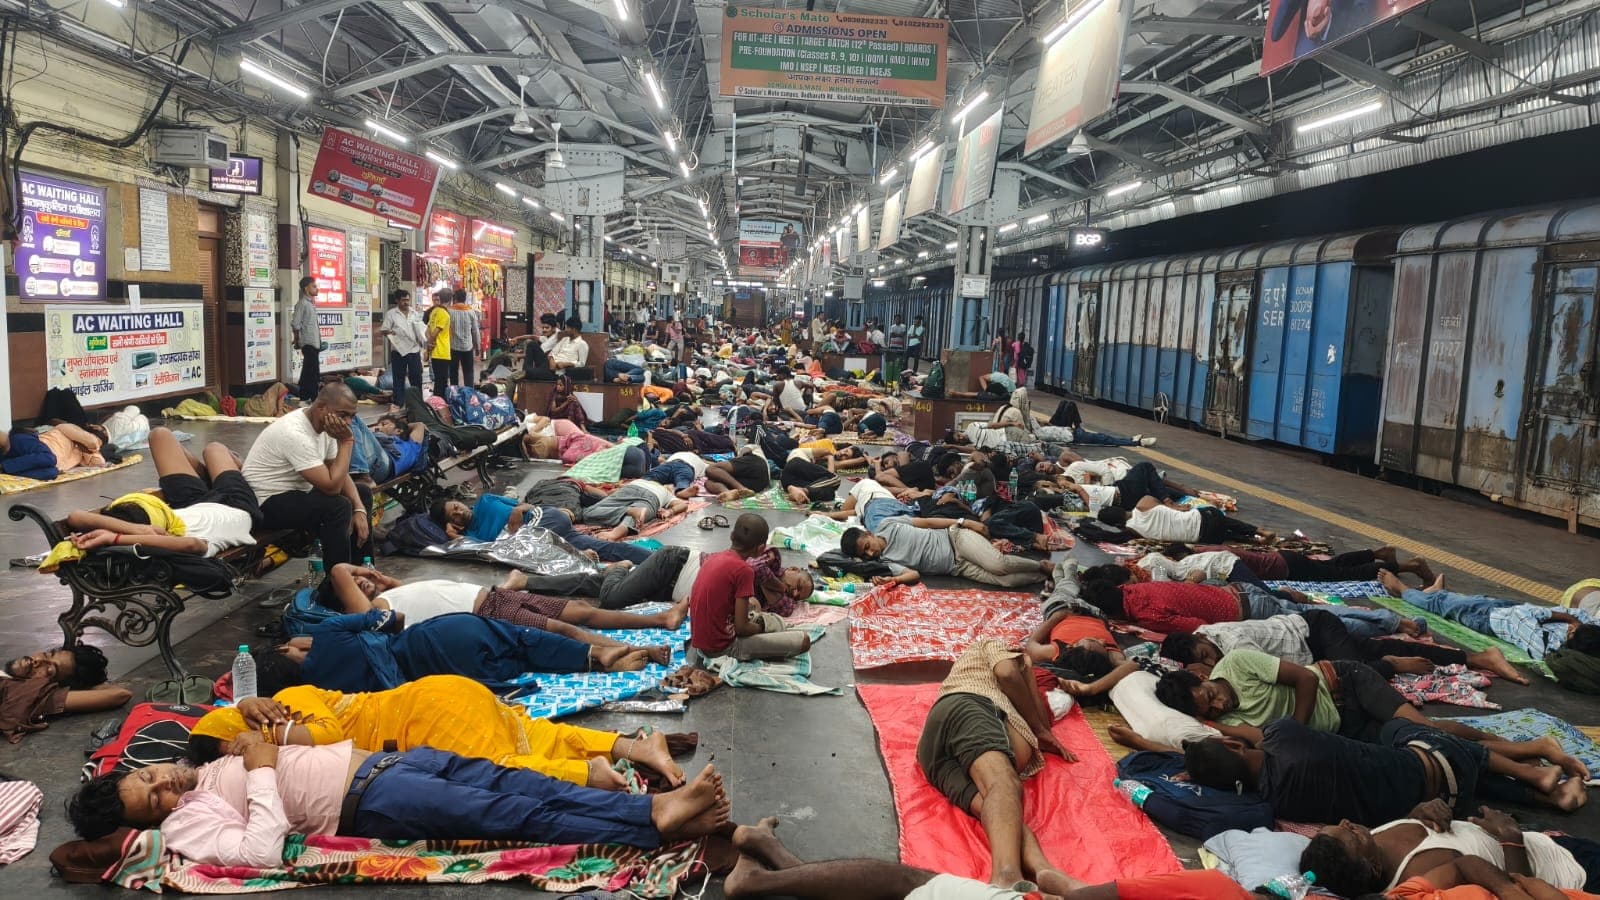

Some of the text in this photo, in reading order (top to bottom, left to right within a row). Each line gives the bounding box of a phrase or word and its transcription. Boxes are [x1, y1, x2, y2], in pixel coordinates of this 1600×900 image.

[741, 8, 796, 20] Scholar's
[786, 24, 887, 39] ADMISSIONS OPEN
[734, 32, 747, 41] FOR
[779, 35, 794, 45] NEET
[801, 37, 826, 47] TARGET
[828, 39, 850, 48] BATCH
[904, 43, 932, 53] BOARDS
[738, 46, 795, 58] PRE-FOUNDATION
[797, 50, 829, 61] (Classes
[780, 62, 794, 71] IMO
[801, 63, 817, 72] NSEP
[869, 67, 892, 77] NSEJS
[341, 138, 354, 147] AC
[356, 141, 394, 160] WAITING
[396, 155, 419, 169] HALL
[22, 182, 101, 206] AC WAITING HALL
[1076, 234, 1101, 245] BGP
[75, 312, 182, 331] AC WAITING HALL
[327, 314, 342, 325] HALL
[1263, 310, 1284, 327] SER
[191, 366, 202, 379] AC
